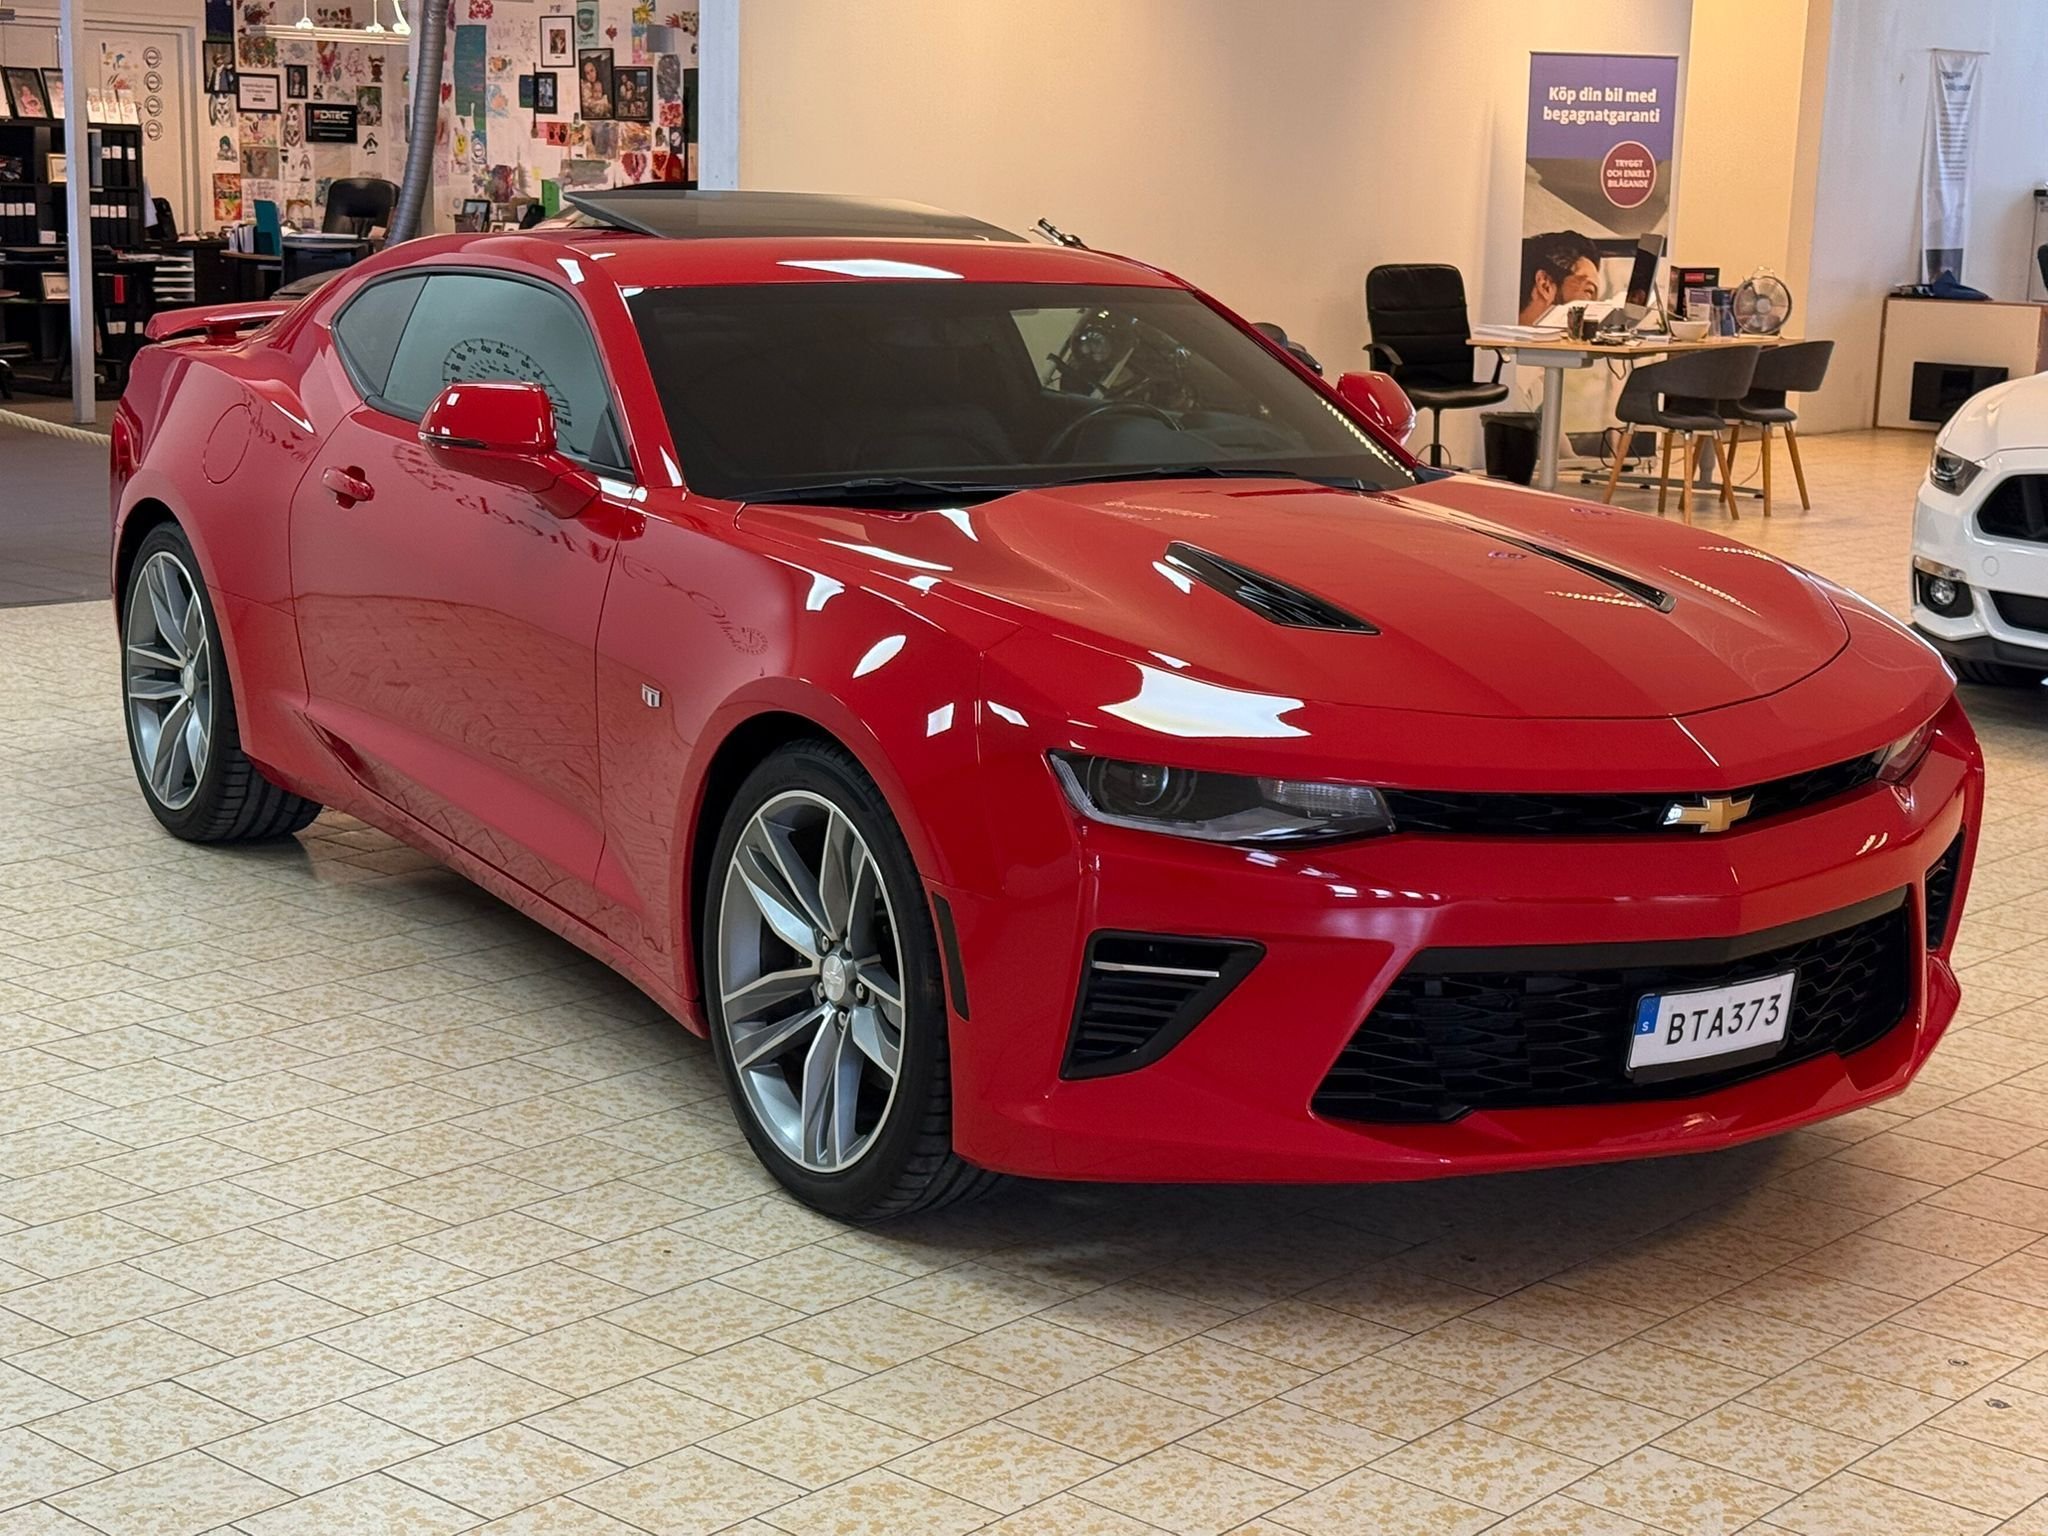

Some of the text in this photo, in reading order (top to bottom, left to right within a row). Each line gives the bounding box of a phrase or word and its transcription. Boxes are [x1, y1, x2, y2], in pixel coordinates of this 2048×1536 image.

[1549, 86, 1657, 105] Köp din bil med
[1543, 105, 1661, 125] begagnatgaranti
[1615, 159, 1644, 168] TRYGGT
[1606, 169, 1651, 178] OCH ENKELT
[1641, 1021, 1650, 1032] S
[1666, 993, 1782, 1045] BTA373
